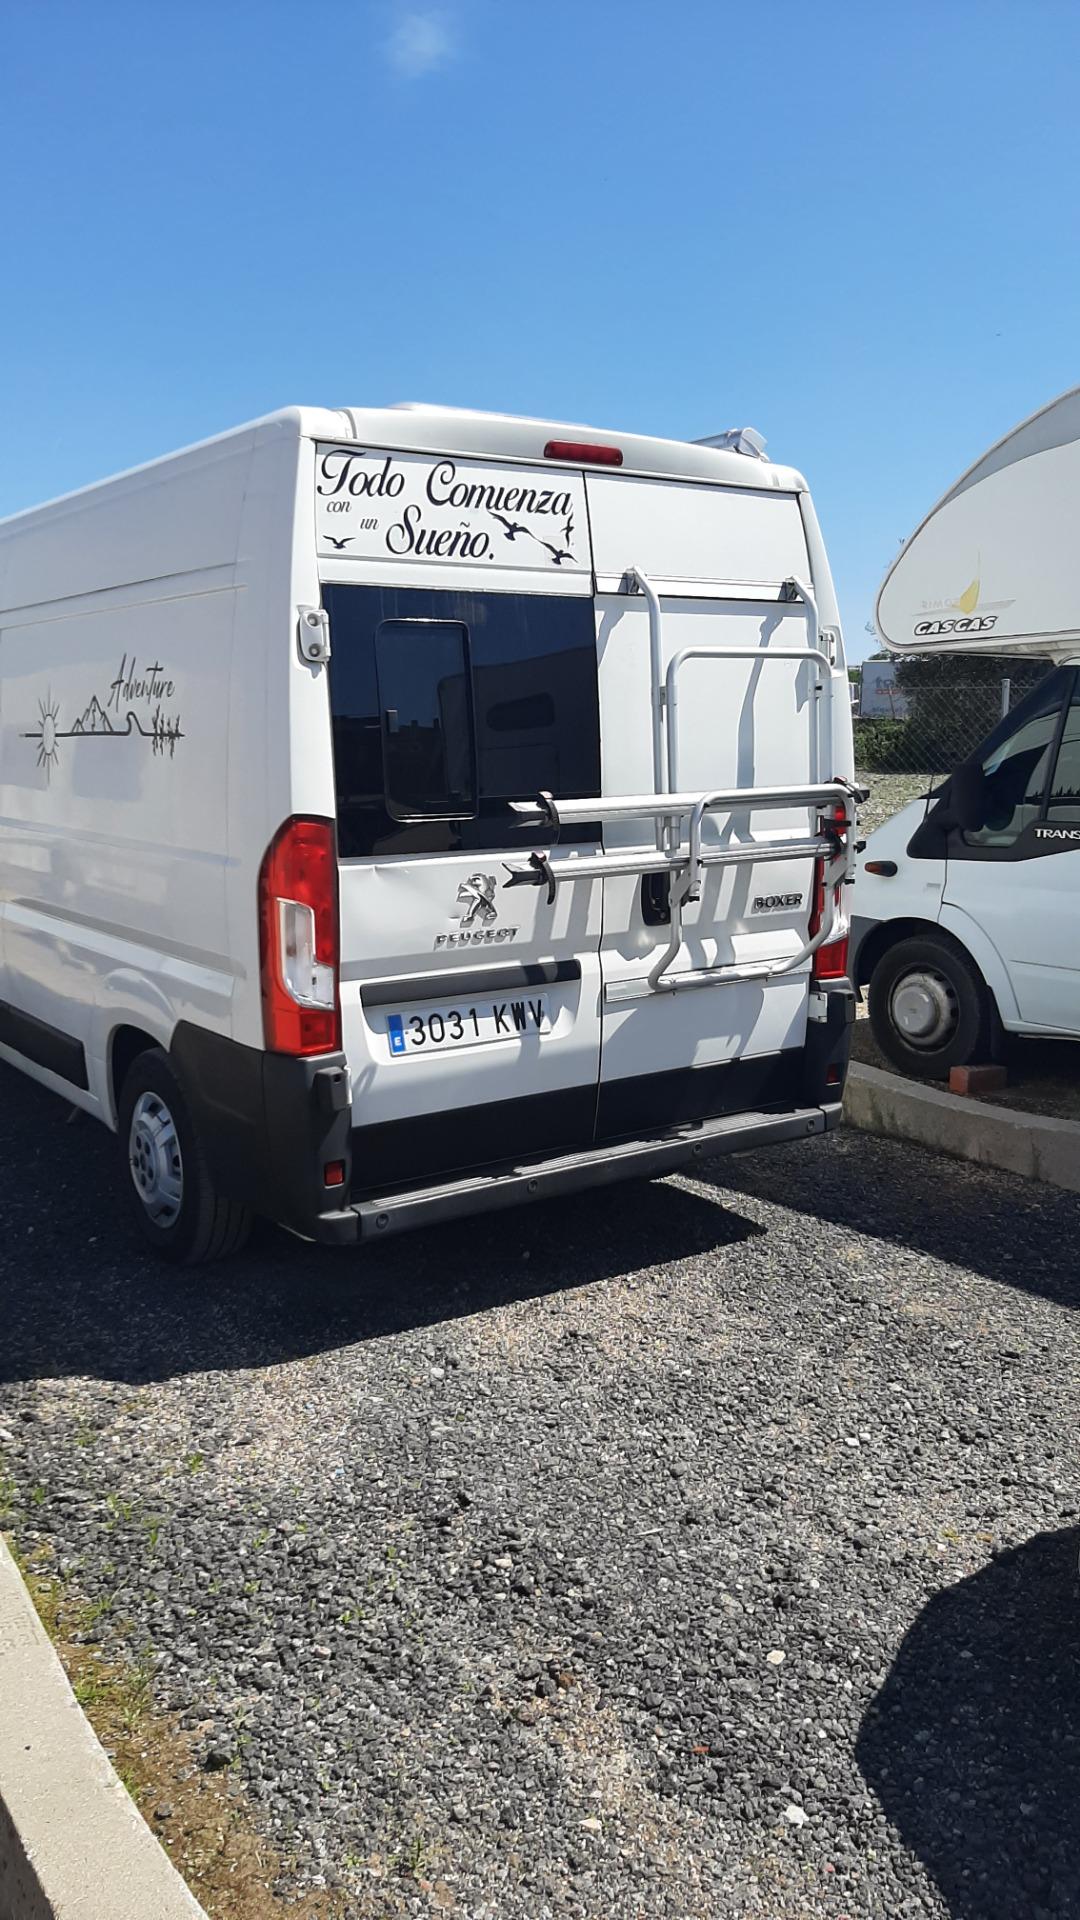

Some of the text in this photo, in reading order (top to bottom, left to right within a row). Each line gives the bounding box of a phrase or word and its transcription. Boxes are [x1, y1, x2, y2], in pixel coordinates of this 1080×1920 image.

[317, 449, 405, 498] Todo
[326, 501, 495, 560] con un Sueño.
[107, 652, 175, 713] Adventure
[753, 892, 803, 910] BOXER
[435, 926, 520, 945] PEUGEOT
[393, 1036, 402, 1046] E
[409, 999, 543, 1046] 3031 KWV
